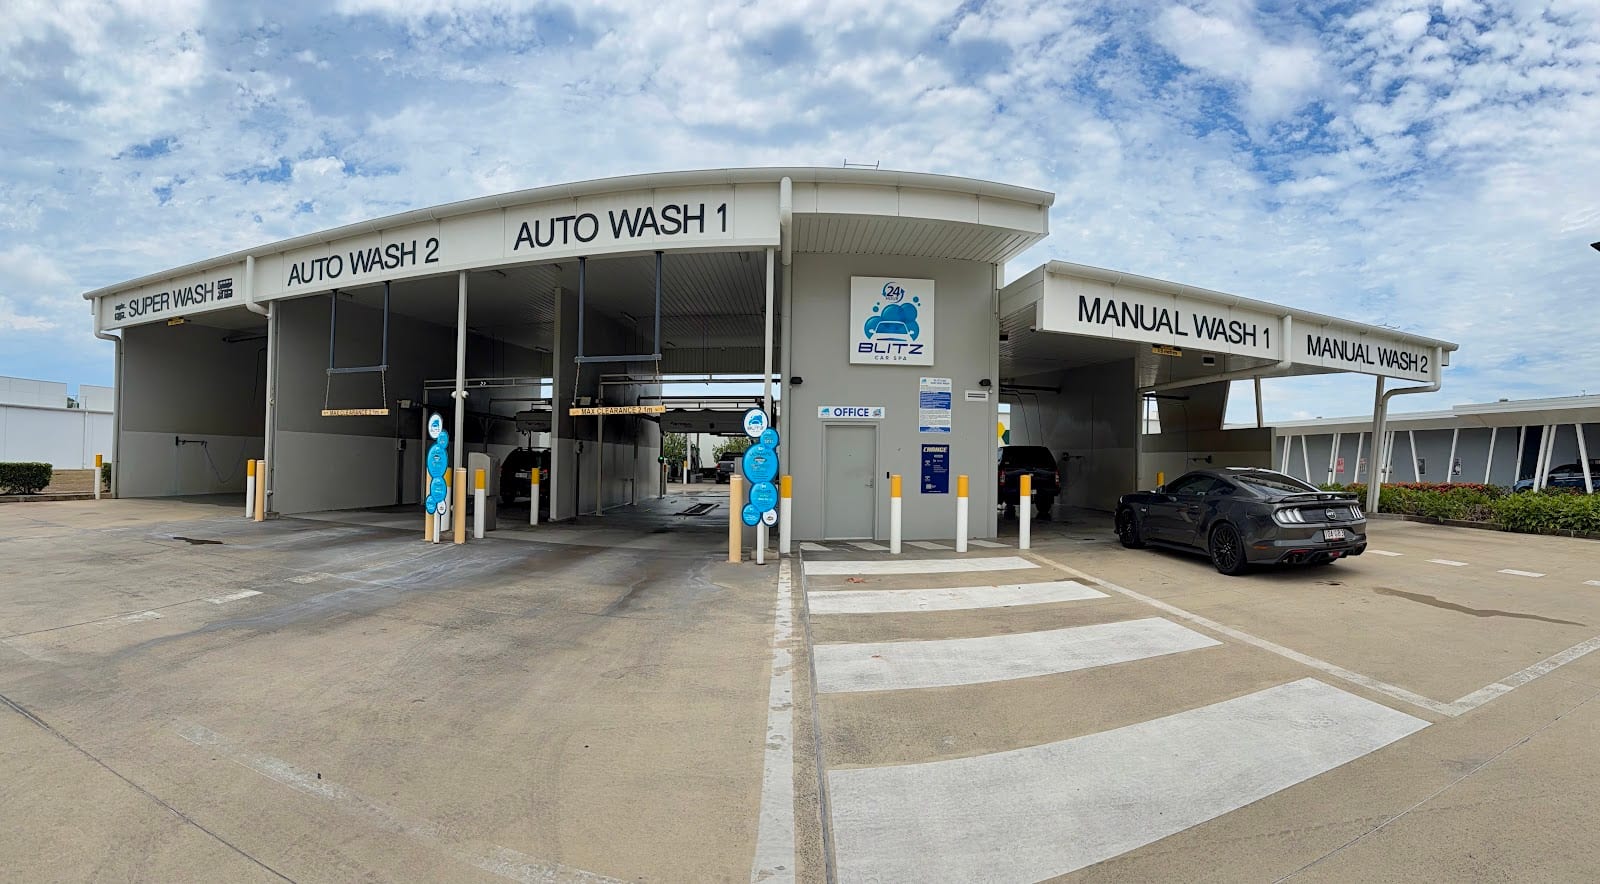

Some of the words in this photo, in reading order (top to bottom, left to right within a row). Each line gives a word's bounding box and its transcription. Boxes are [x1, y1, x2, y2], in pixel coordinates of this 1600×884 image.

[513, 211, 599, 251] AUTO
[608, 203, 705, 240] WASH
[716, 202, 727, 233] 1
[287, 254, 343, 286] AUTO
[348, 239, 417, 275] WASH
[424, 237, 440, 264] 2
[128, 291, 170, 318] SUPER
[172, 281, 215, 309] WASH
[886, 285, 900, 297] 24
[1078, 295, 1189, 337] MANUAL
[1192, 313, 1257, 347] WASH
[1262, 327, 1271, 349] 1
[857, 342, 924, 355] BLITZ
[1306, 334, 1375, 366] MANUAL
[1377, 346, 1419, 372] WASH
[1420, 355, 1430, 374] 2
[581, 407, 595, 415] MAX
[596, 406, 636, 415] CLEARANCE
[833, 407, 869, 417] OFFICE
